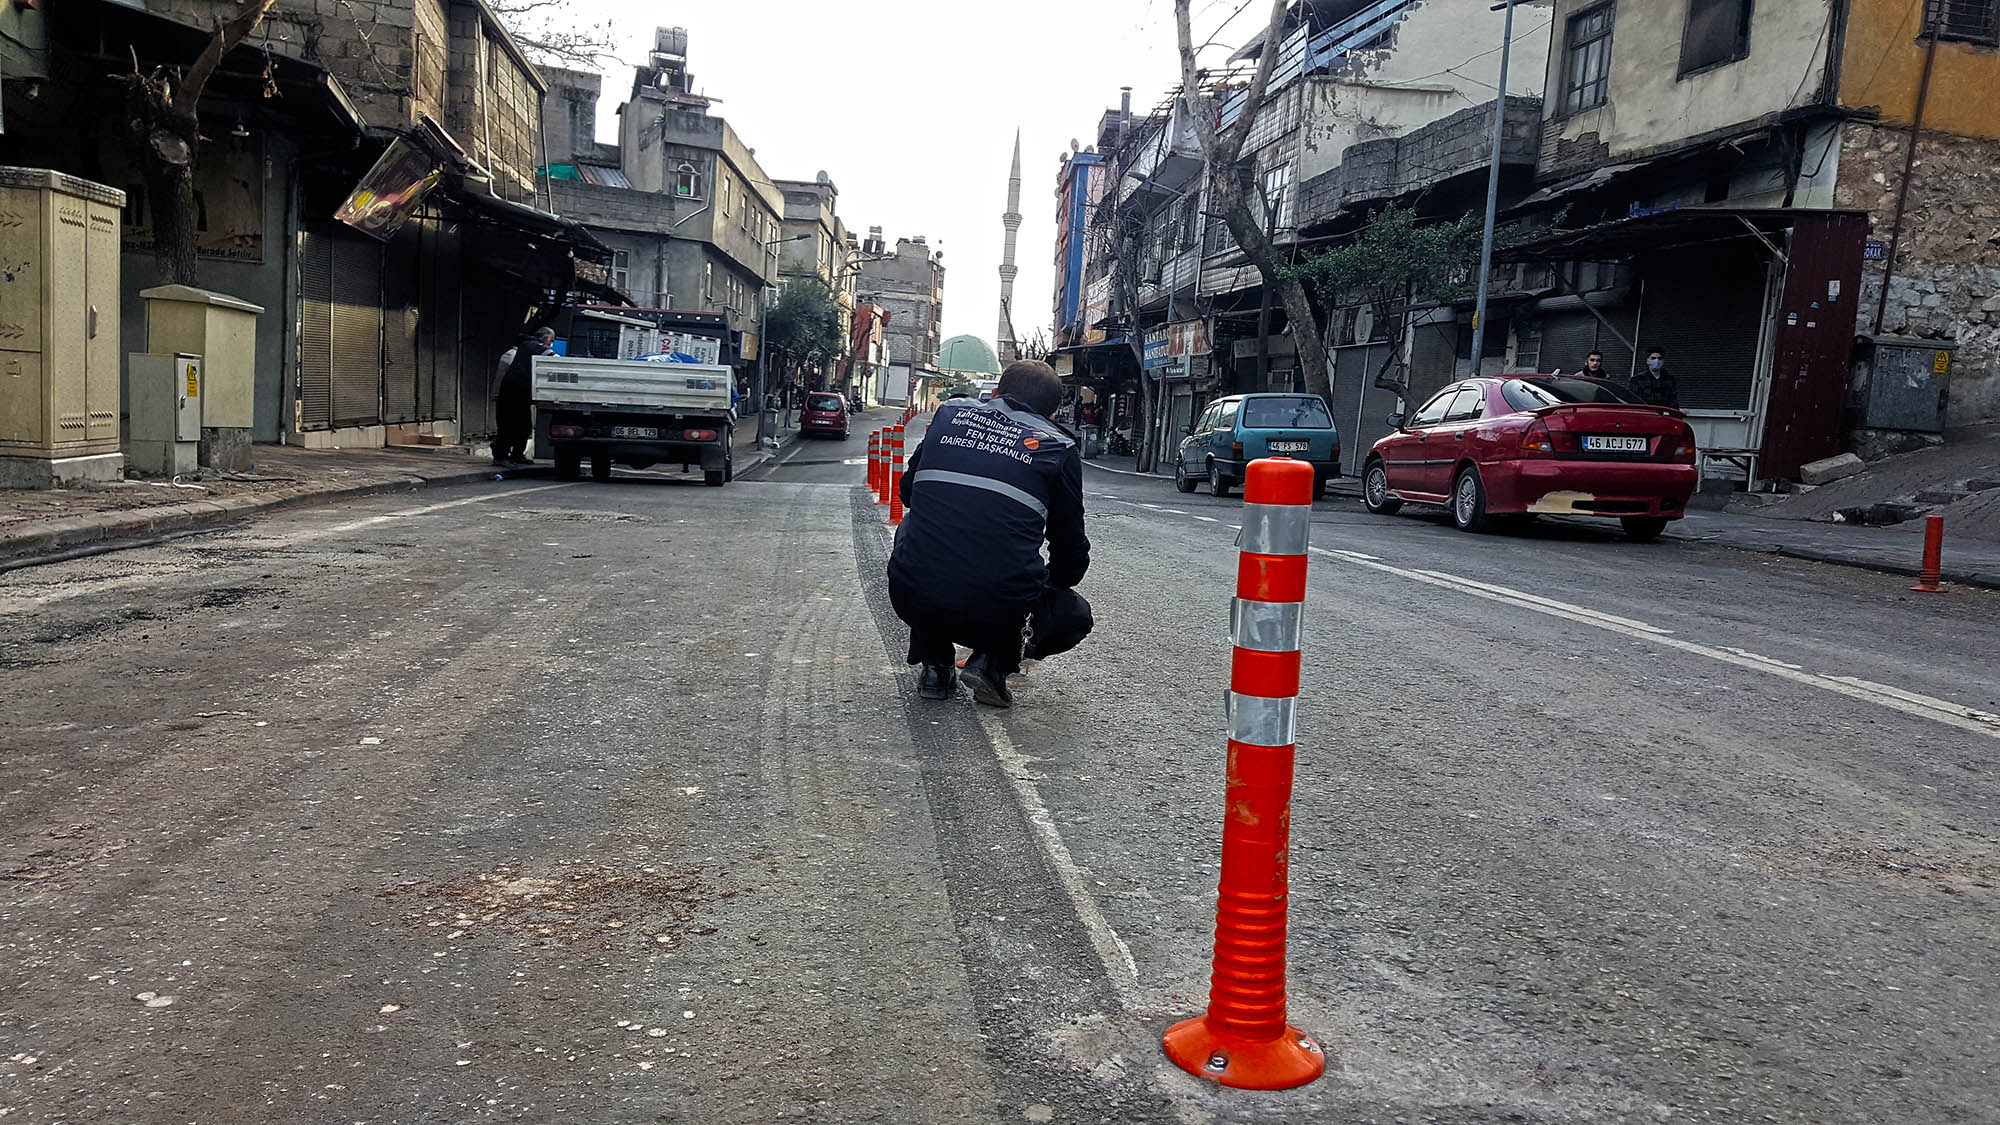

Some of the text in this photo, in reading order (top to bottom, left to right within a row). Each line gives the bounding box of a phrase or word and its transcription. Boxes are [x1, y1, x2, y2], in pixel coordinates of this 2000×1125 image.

[966, 429, 1017, 447] FEN İŞLERİ
[1590, 438, 1643, 450] 46 ACJ 677
[940, 435, 1033, 465] DAİRESİ BAŞKANLIĞI
[1272, 442, 1280, 450] 46
